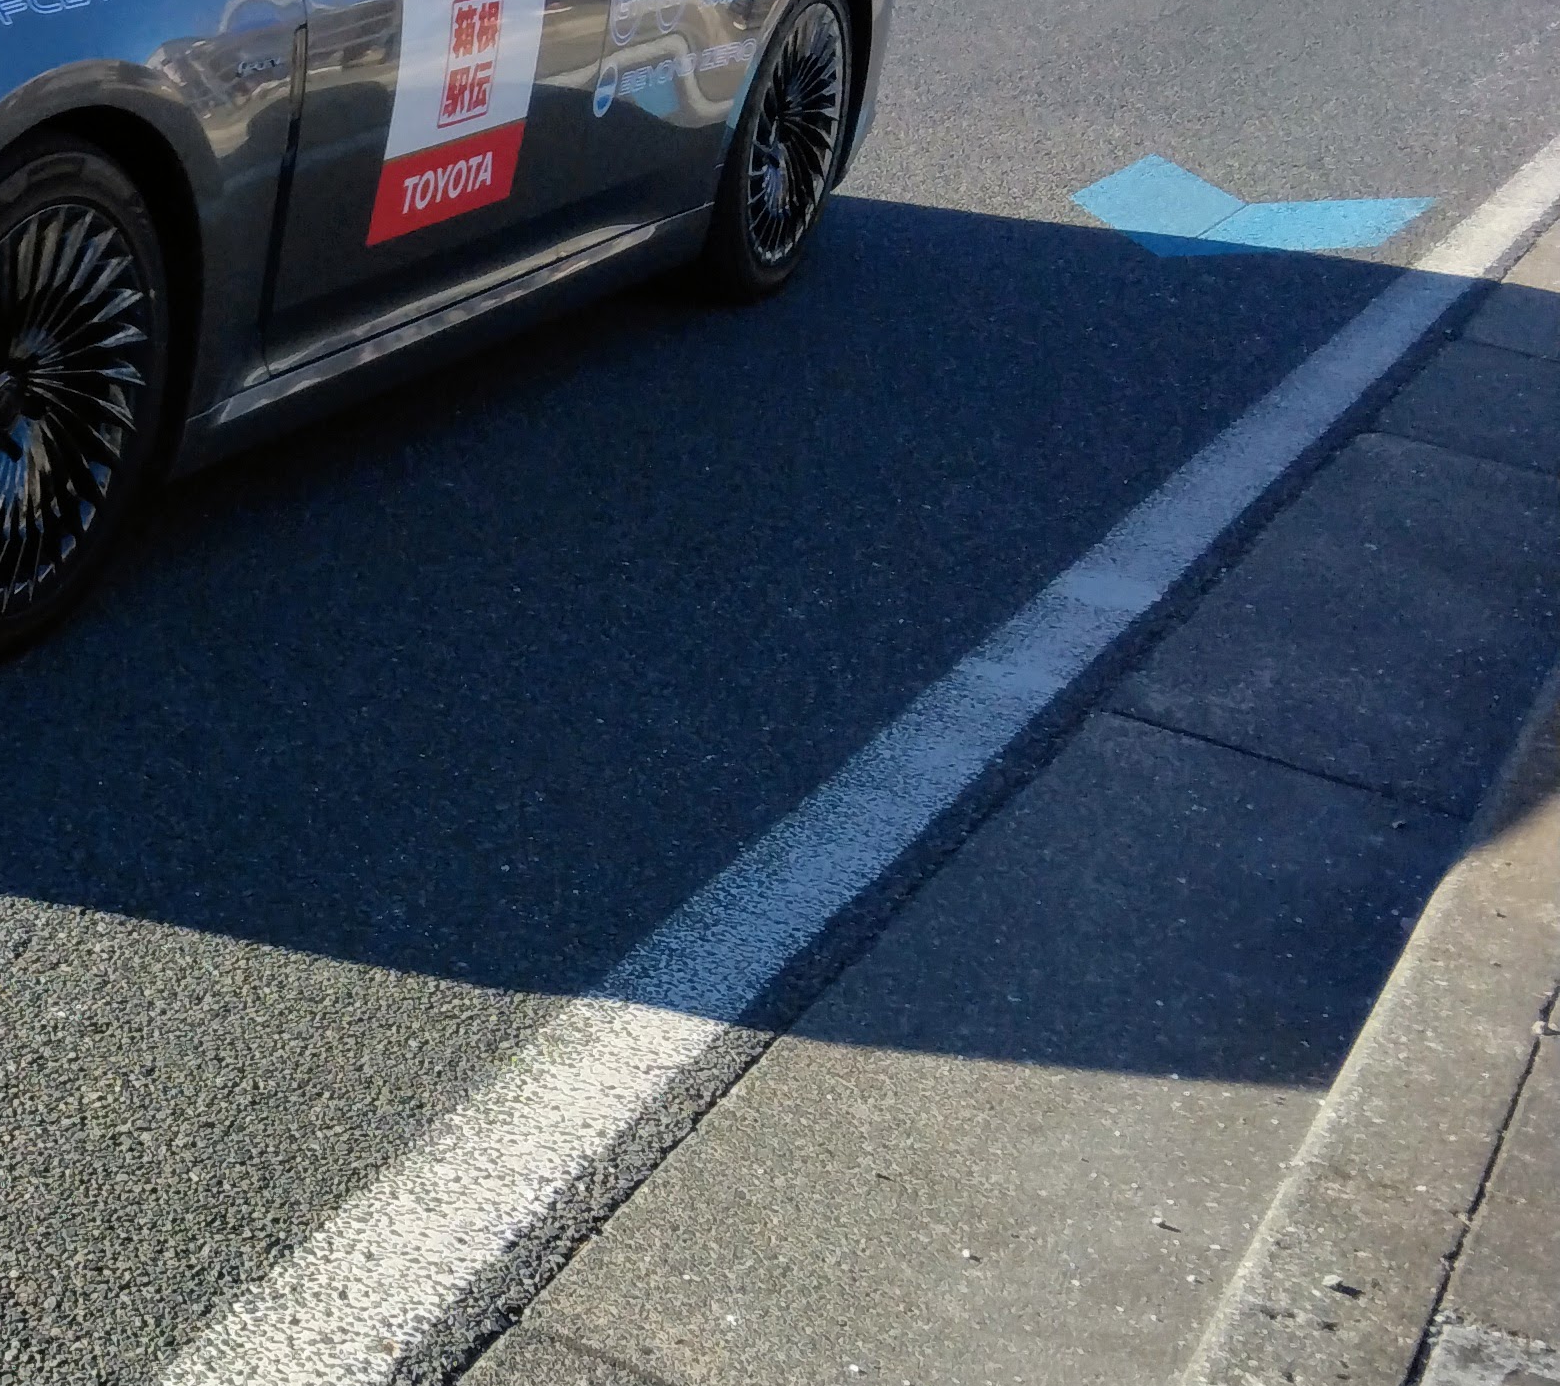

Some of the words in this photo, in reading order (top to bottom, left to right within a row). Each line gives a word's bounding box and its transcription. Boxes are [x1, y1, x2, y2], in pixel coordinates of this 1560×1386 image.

[452, 0, 501, 60] 箱根
[699, 38, 757, 72] ZERO
[442, 61, 493, 118] 駅伝
[402, 151, 493, 215] TOYOTA
